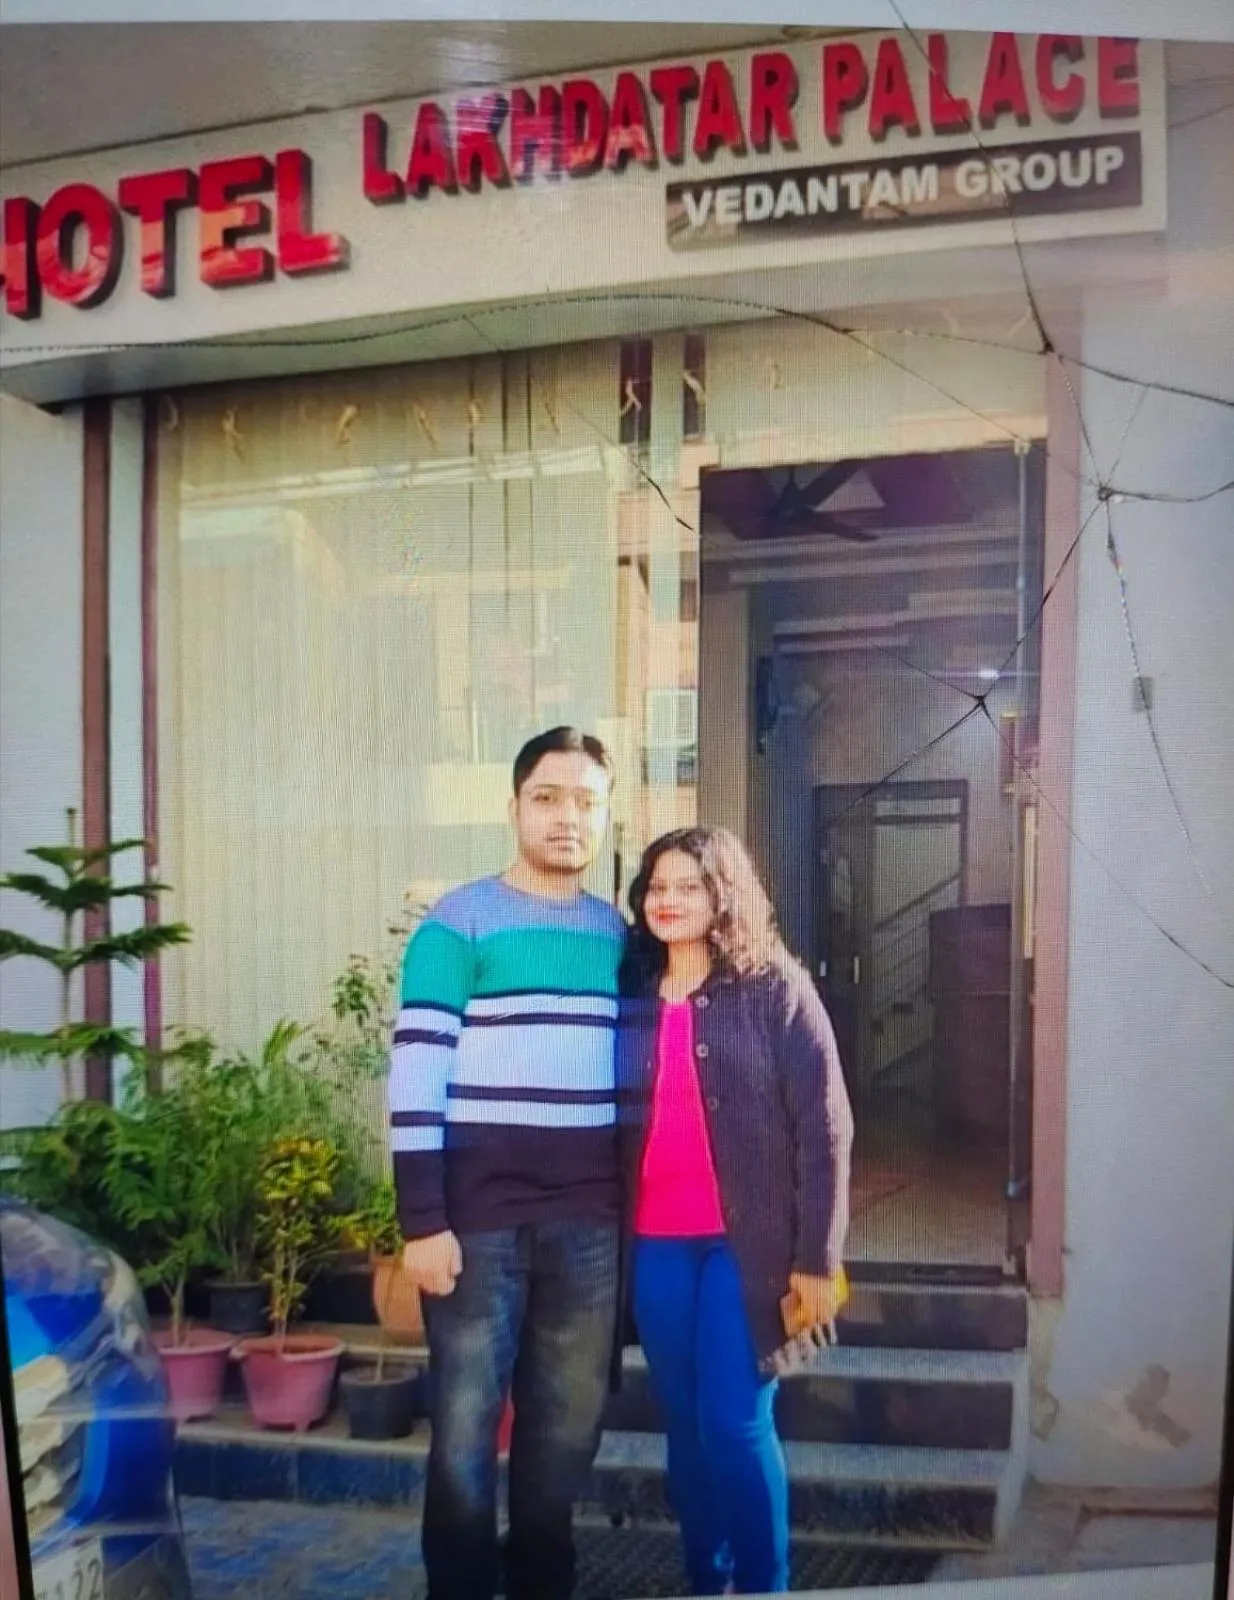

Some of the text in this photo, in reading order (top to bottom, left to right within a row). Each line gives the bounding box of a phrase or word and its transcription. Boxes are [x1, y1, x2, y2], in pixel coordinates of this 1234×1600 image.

[363, 51, 800, 205] LAKHDATAR
[821, 32, 1140, 144] PALACE
[681, 146, 1126, 229] VEDANTAM GROUP
